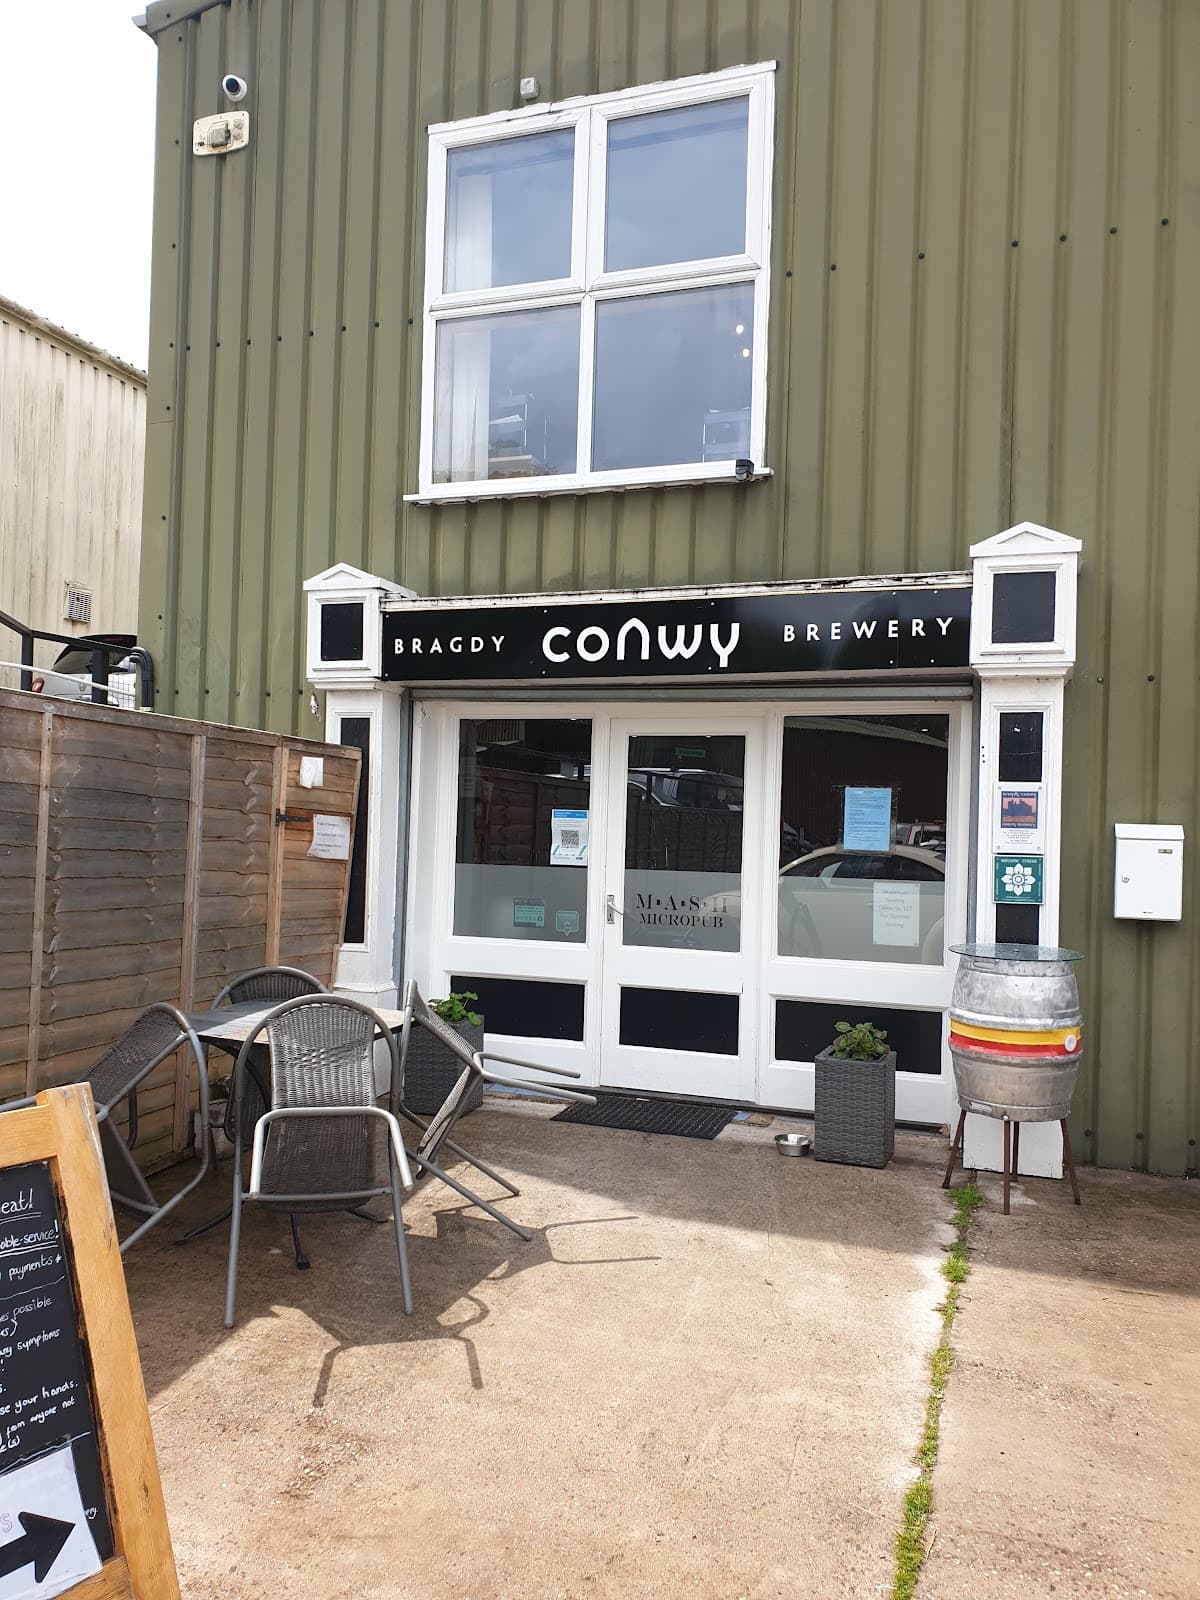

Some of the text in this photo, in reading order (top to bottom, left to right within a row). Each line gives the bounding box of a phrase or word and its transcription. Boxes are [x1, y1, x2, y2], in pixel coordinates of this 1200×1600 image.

[395, 635, 506, 655] BRAGDY
[783, 616, 954, 643] BREWERY
[639, 913, 724, 928] MICROPUB
[0, 1219, 60, 1249] able-service!
[8, 1253, 53, 1281] payments
[13, 1295, 53, 1321] possible
[17, 1328, 61, 1352] symptoms
[15, 1394, 39, 1414] your
[62, 1396, 76, 1409] not
